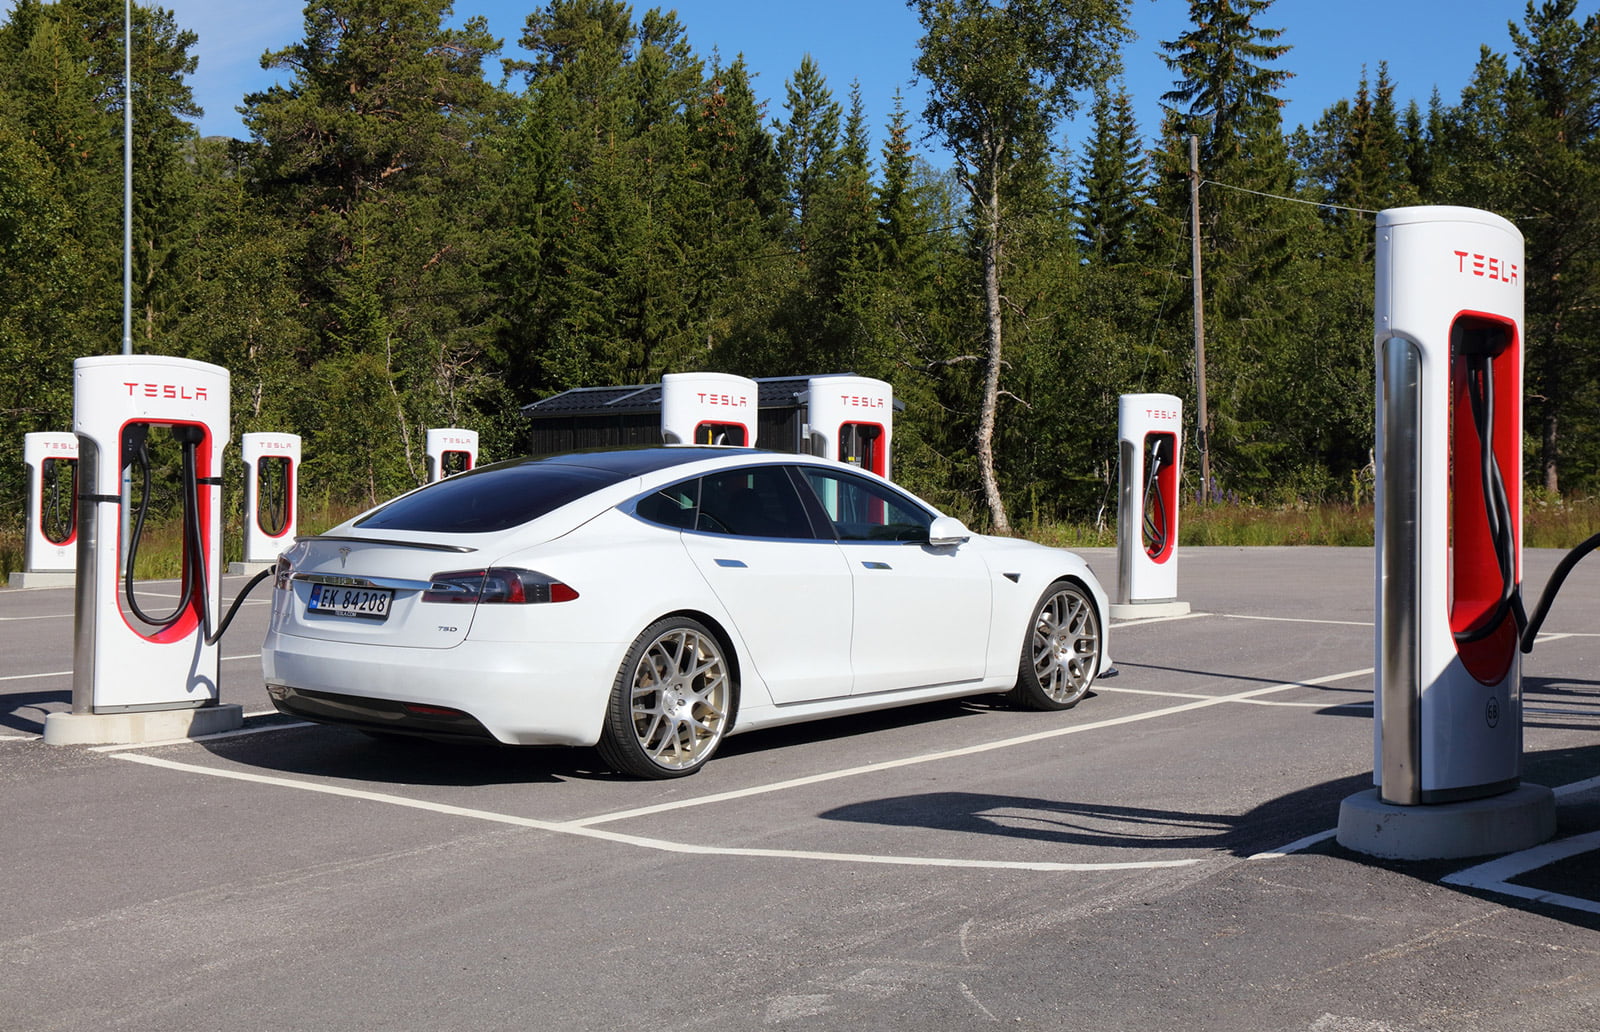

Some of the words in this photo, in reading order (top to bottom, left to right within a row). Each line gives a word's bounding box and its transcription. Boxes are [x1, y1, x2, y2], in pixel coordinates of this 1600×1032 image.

[1454, 250, 1518, 285] TESLA
[123, 382, 208, 401] TESLA
[697, 392, 747, 407] TESLA
[841, 395, 884, 408] TESLA
[1146, 409, 1177, 420] TESLA
[259, 441, 292, 449] TESLA
[320, 589, 340, 609] EK
[342, 590, 387, 612] 84208
